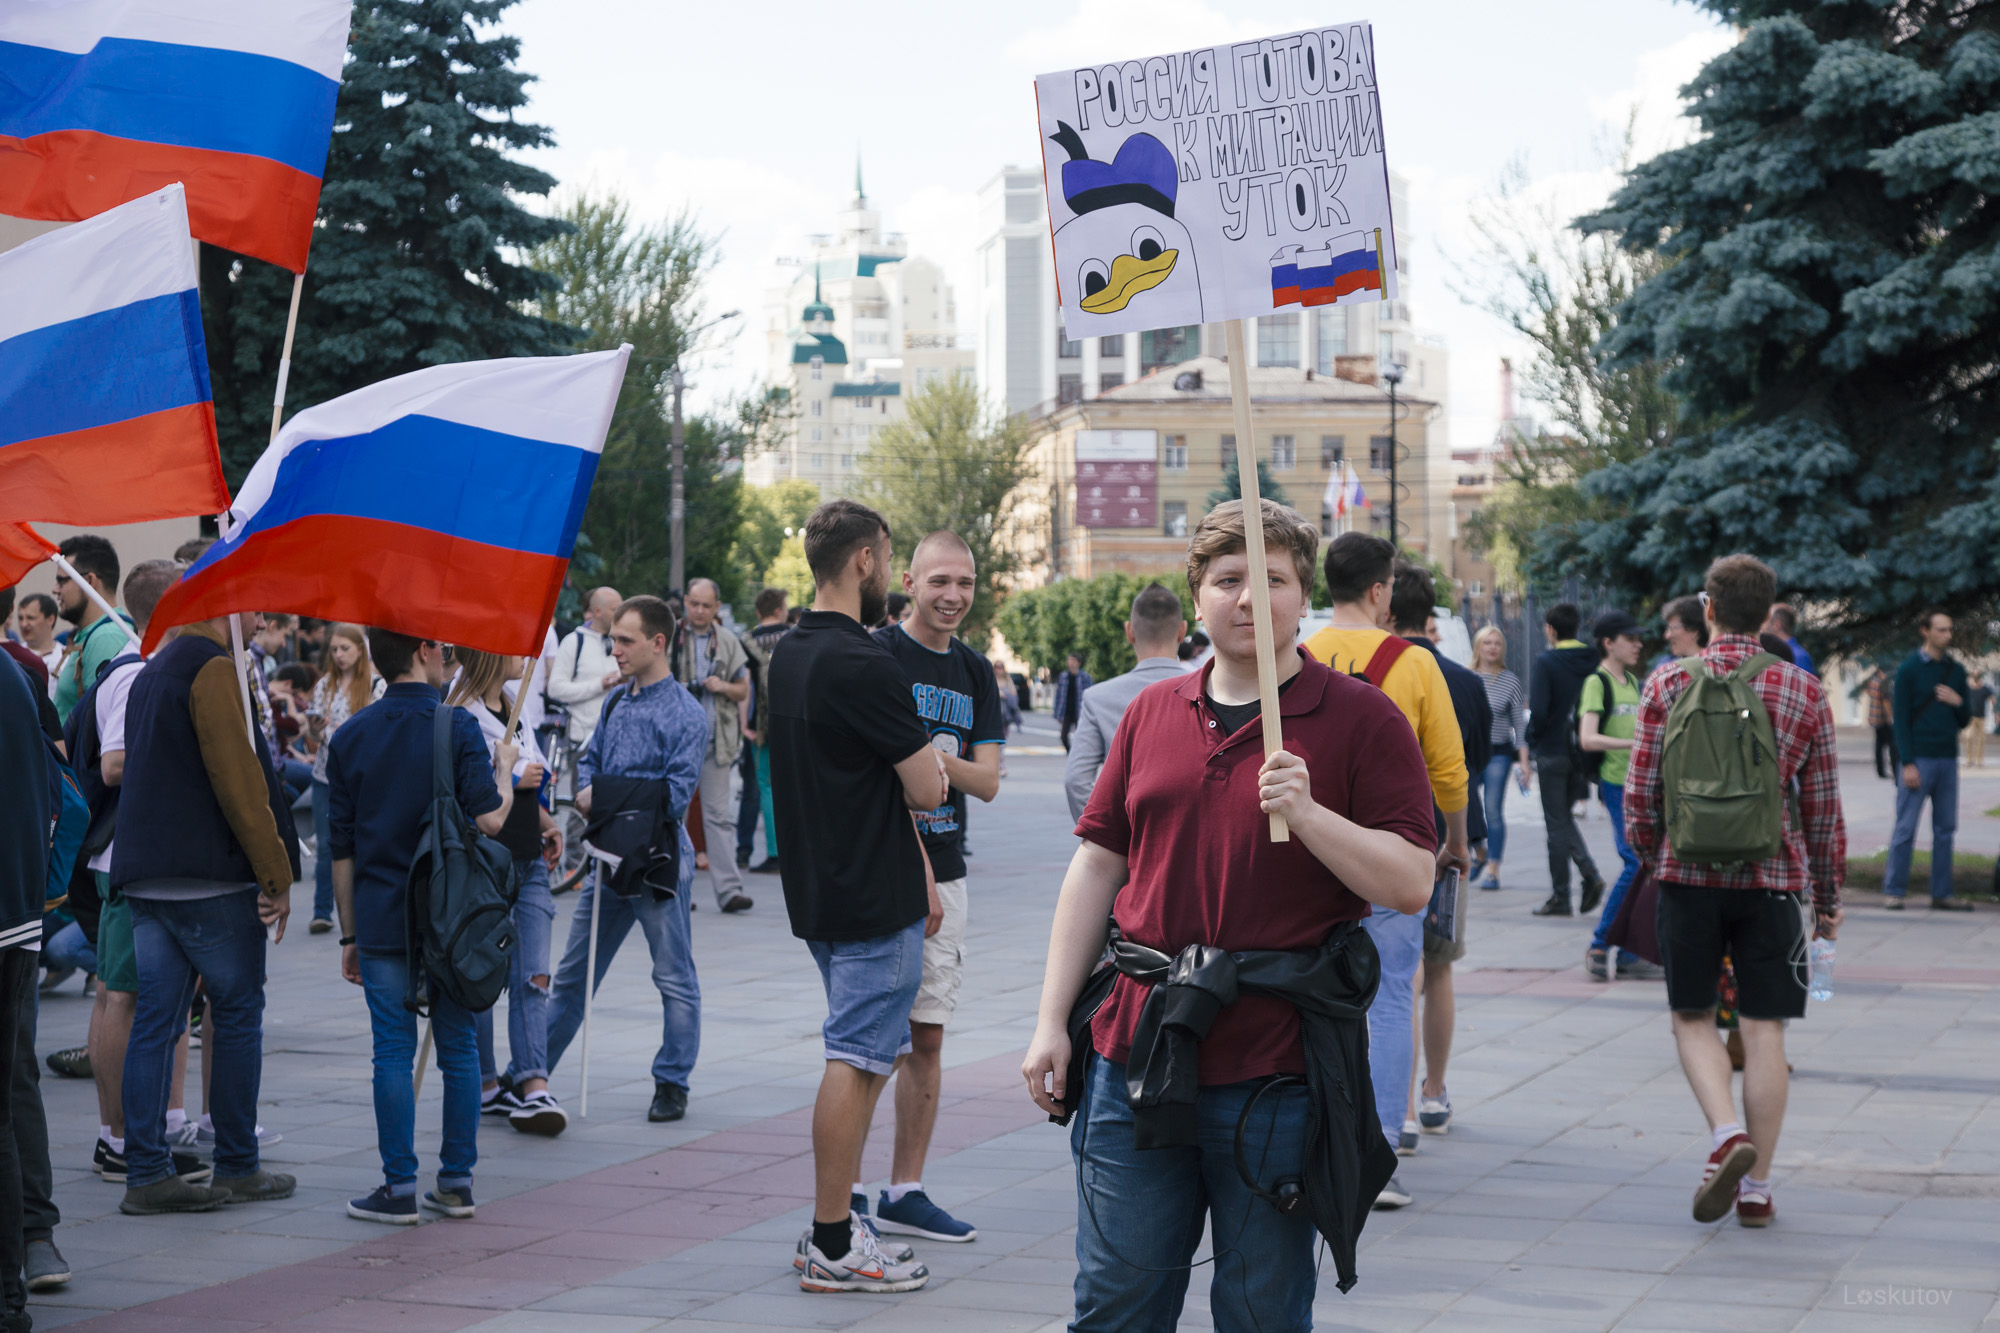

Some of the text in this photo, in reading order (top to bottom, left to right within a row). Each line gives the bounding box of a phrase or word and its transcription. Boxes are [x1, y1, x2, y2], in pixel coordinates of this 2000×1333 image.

[1075, 26, 1376, 131] РОССИЯ ГОТОВА
[1174, 92, 1383, 183] К МИГРАЦИИ
[1219, 165, 1350, 241] УТОК
